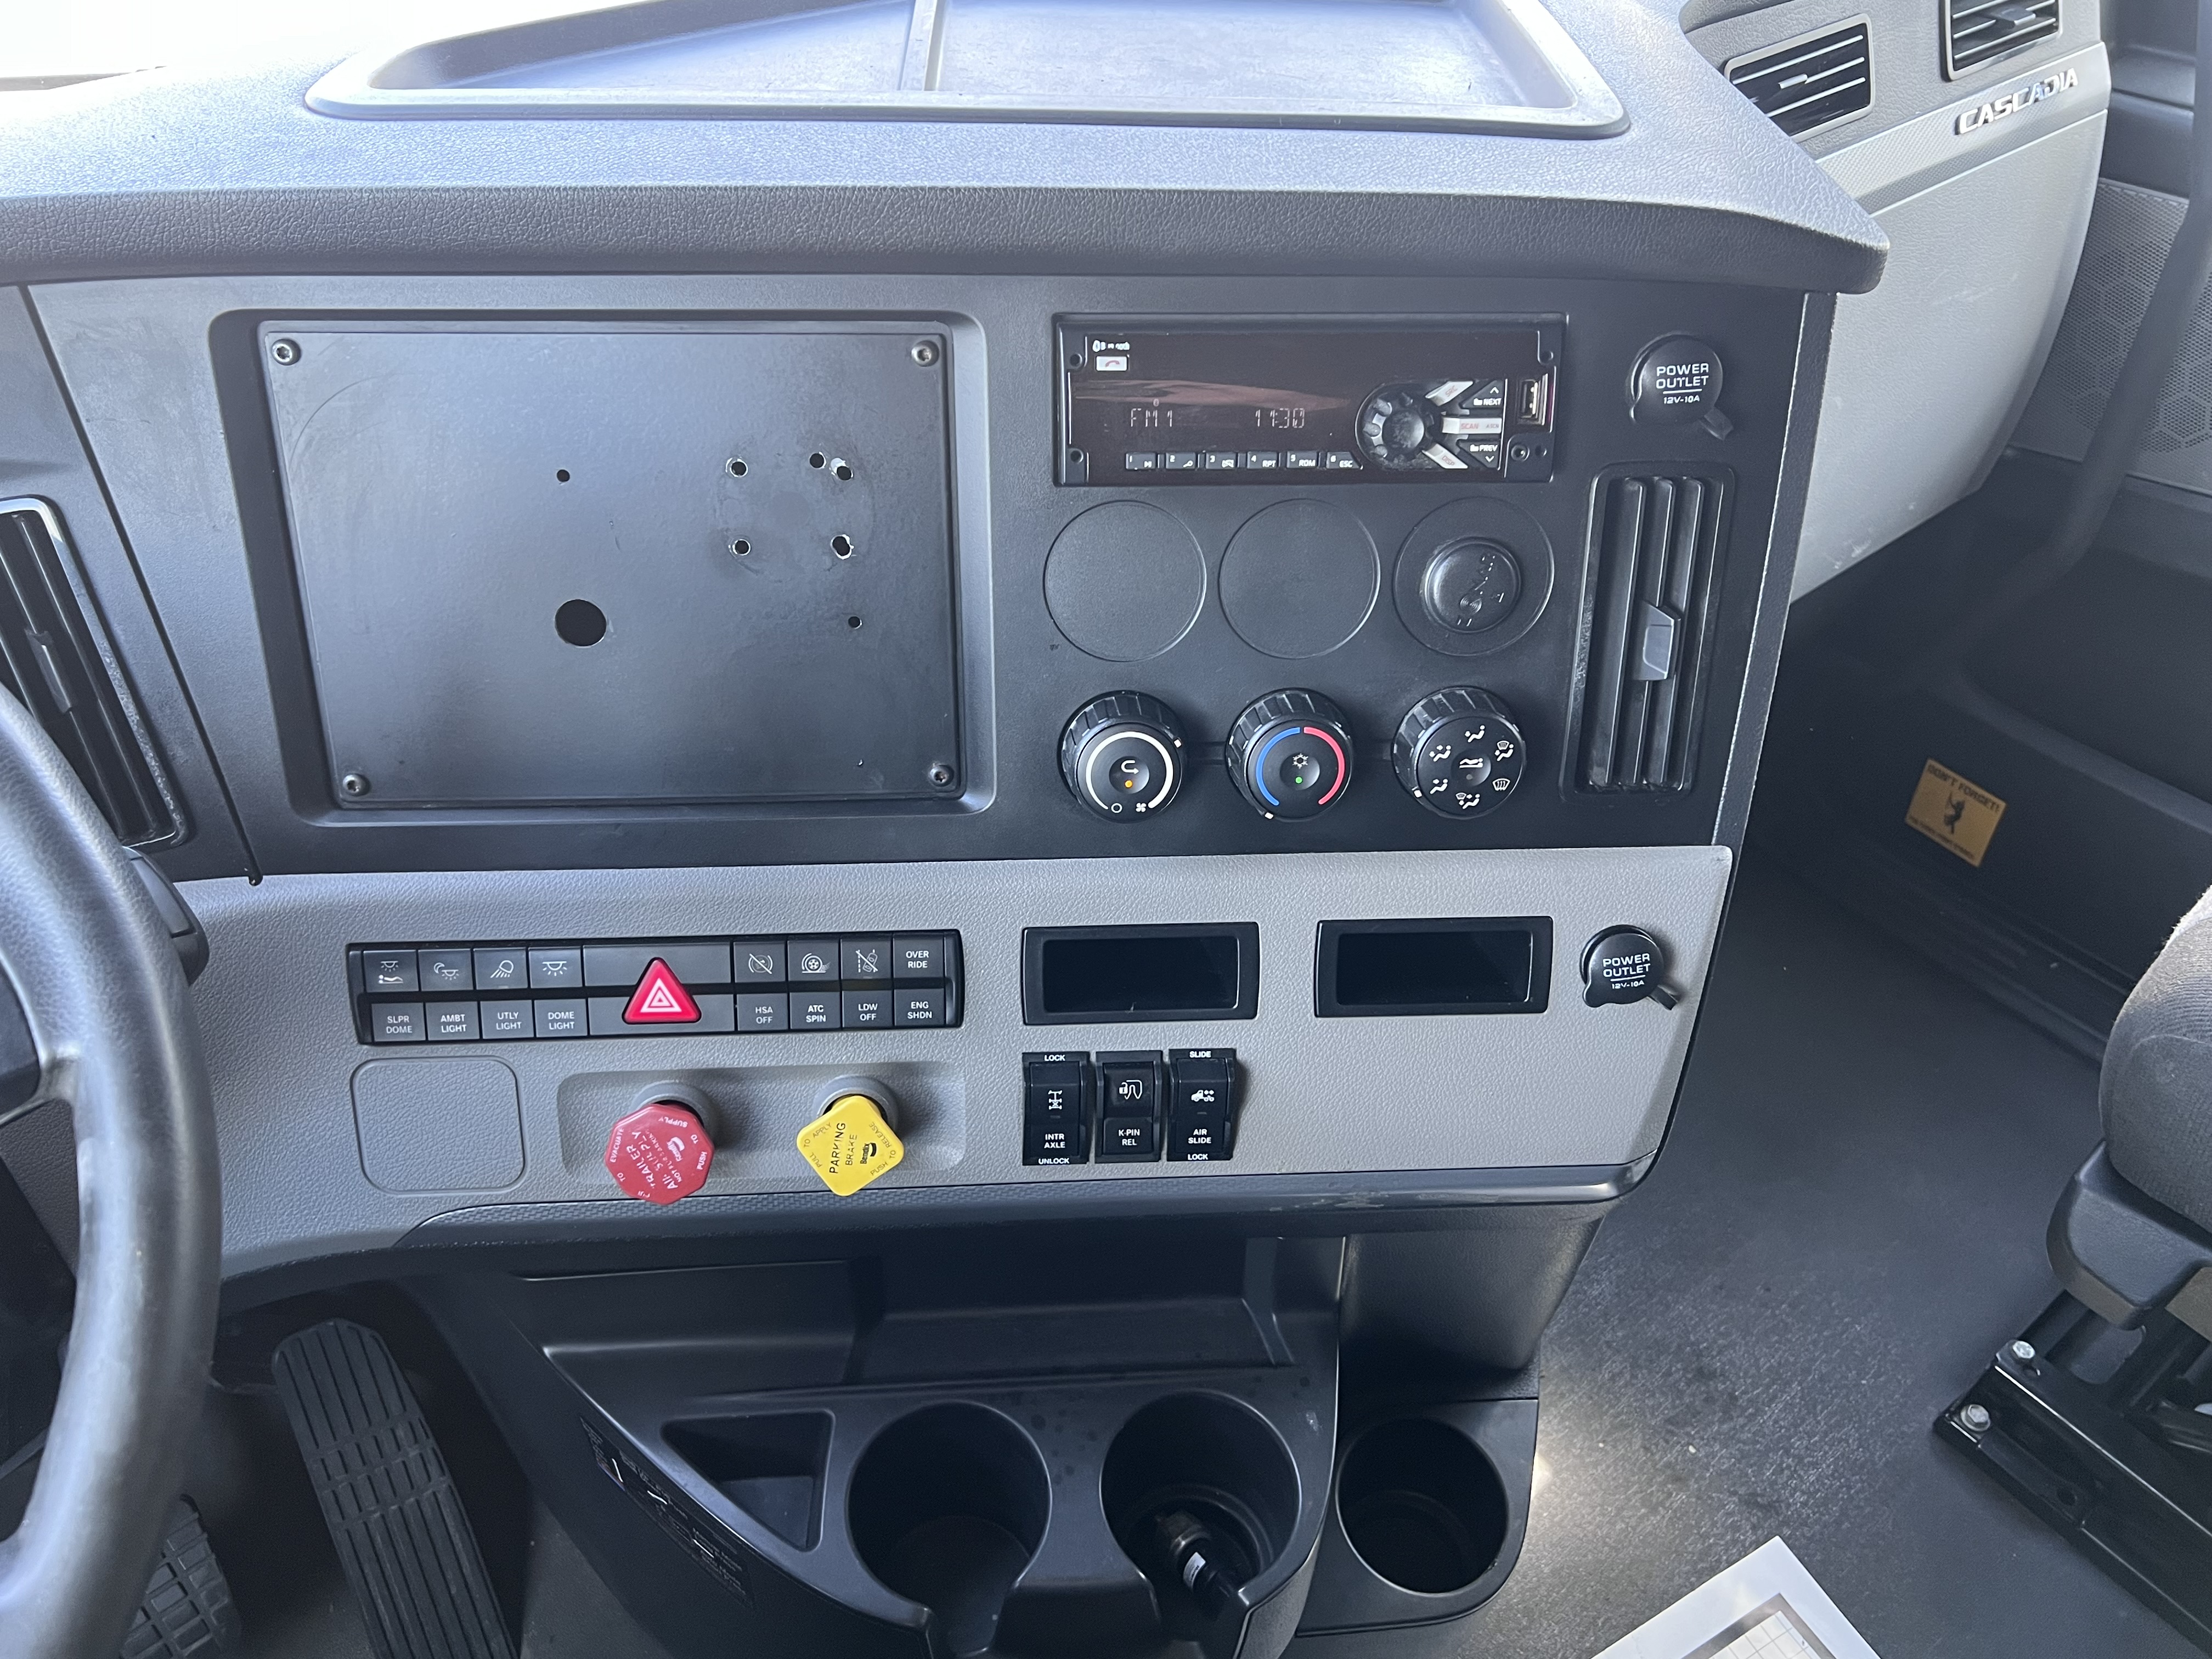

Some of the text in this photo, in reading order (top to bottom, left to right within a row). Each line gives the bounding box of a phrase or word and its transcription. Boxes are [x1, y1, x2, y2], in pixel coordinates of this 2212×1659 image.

[1958, 68, 2078, 134] CASCADIA
[1656, 363, 1709, 376] POWER
[1656, 375, 1709, 389] OUTLET
[1445, 385, 1458, 397] SRC
[1663, 395, 1700, 404] 12V-10A
[1255, 408, 1305, 428] 11:30
[1442, 455, 1455, 466] DISP
[906, 951, 929, 959] OVER
[908, 960, 928, 969] RIDE
[1602, 953, 1650, 967] POWER
[1603, 963, 1651, 977] OUTLET
[1612, 980, 1645, 989] 12V-10A
[808, 1005, 824, 1013] ATC
[858, 1003, 878, 1011] LDW
[911, 1001, 929, 1009] ENG
[387, 1015, 410, 1024] SLPR
[441, 1014, 465, 1023] AMBT
[498, 1012, 518, 1020] UTLY
[548, 1011, 575, 1020] DOME
[806, 1014, 826, 1023] SPIN
[860, 1013, 877, 1021] OFF
[907, 1011, 932, 1019] SHDN
[756, 1016, 773, 1024] OFF
[386, 1025, 413, 1034] DOME
[441, 1024, 467, 1033] LIGHT
[496, 1022, 522, 1030] LIGHT
[549, 1021, 574, 1030] LIGHT
[658, 1116, 708, 1170] PUSH TO SUPPLY
[1188, 1136, 1211, 1144] SLIDE
[610, 1128, 624, 1163] EVACUATE
[804, 1122, 832, 1168] PULL TO APPLY
[830, 1122, 846, 1174] PARKING
[868, 1121, 896, 1176] PUSH TO RELEASE
[845, 1135, 857, 1166] BRAKE
[860, 1143, 871, 1164] Bendix
[626, 1144, 656, 1189] TRAILER
[617, 1172, 626, 1182] TO
[671, 1169, 682, 1183] NOT
